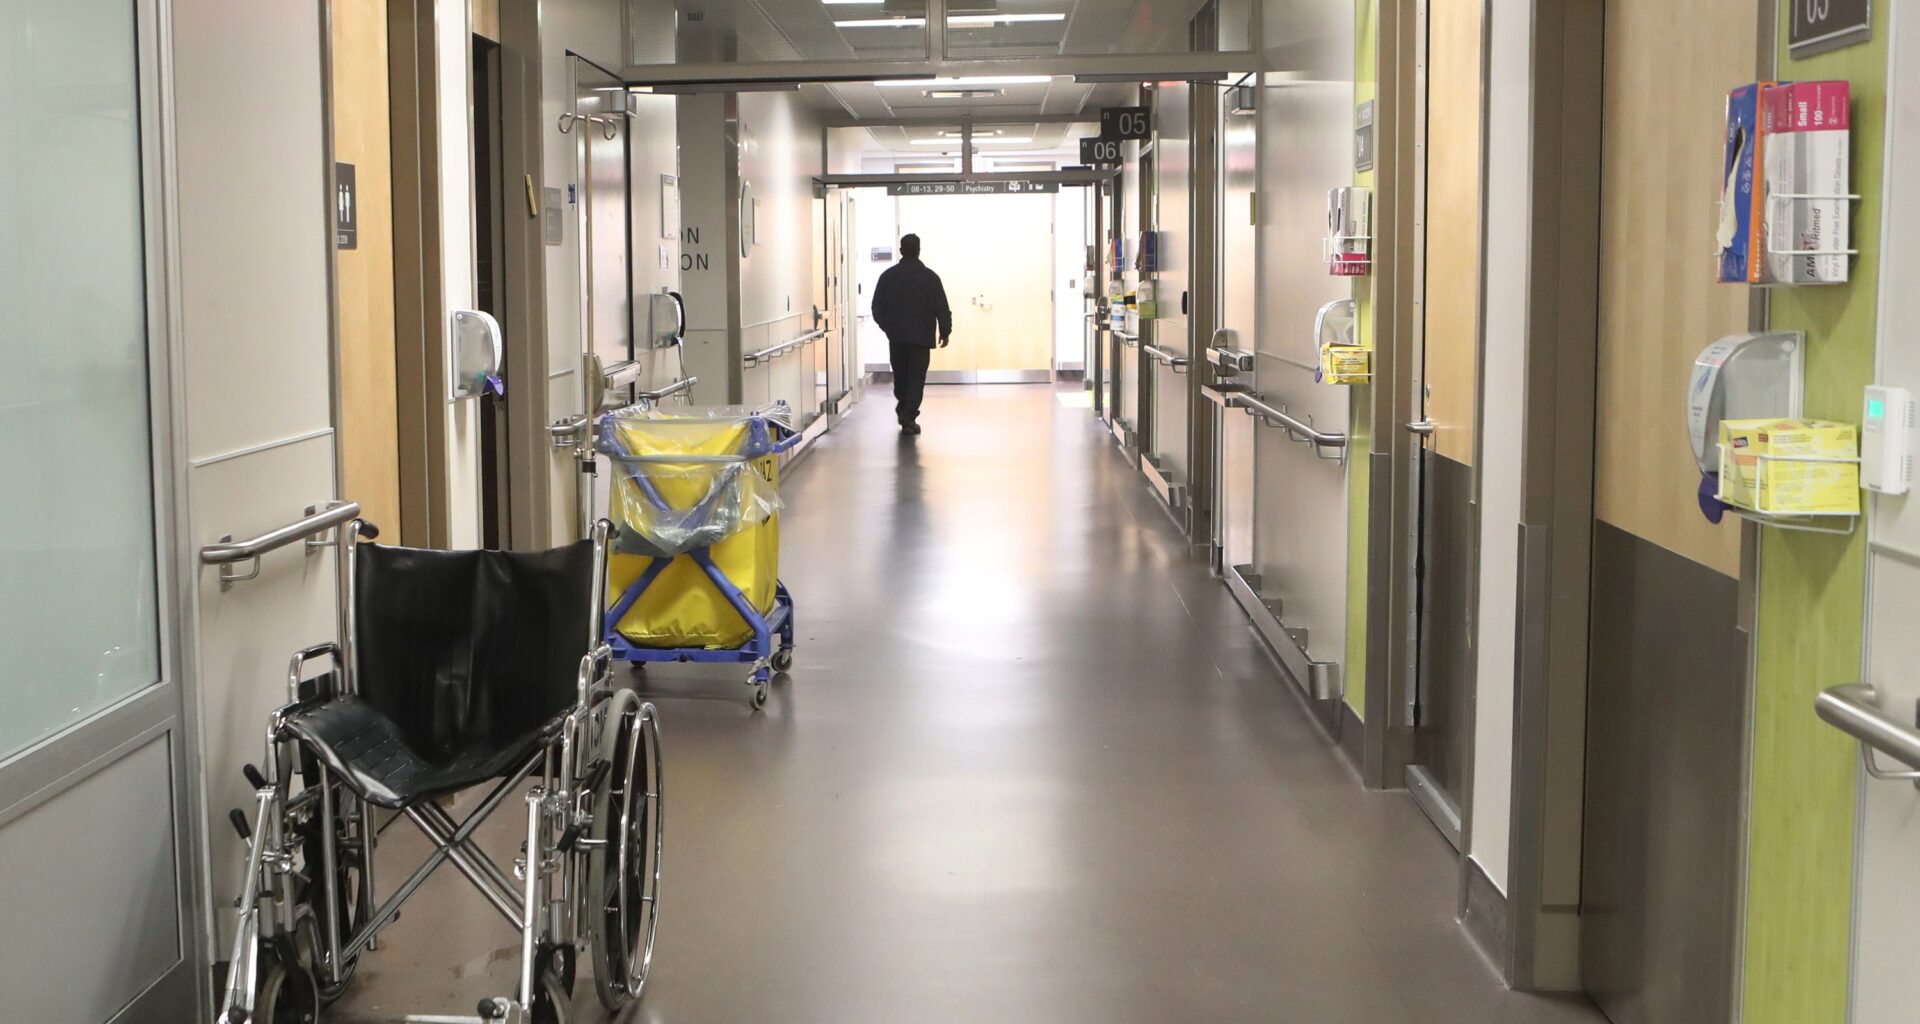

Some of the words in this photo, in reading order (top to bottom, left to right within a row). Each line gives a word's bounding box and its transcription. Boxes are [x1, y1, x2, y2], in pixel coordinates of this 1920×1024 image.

[1798, 101, 1808, 127] Small
[1814, 110, 1823, 127] 100
[1120, 113, 1146, 135] 05
[1094, 141, 1116, 160] 06
[965, 184, 995, 194] Psychiatry
[681, 227, 699, 244] N
